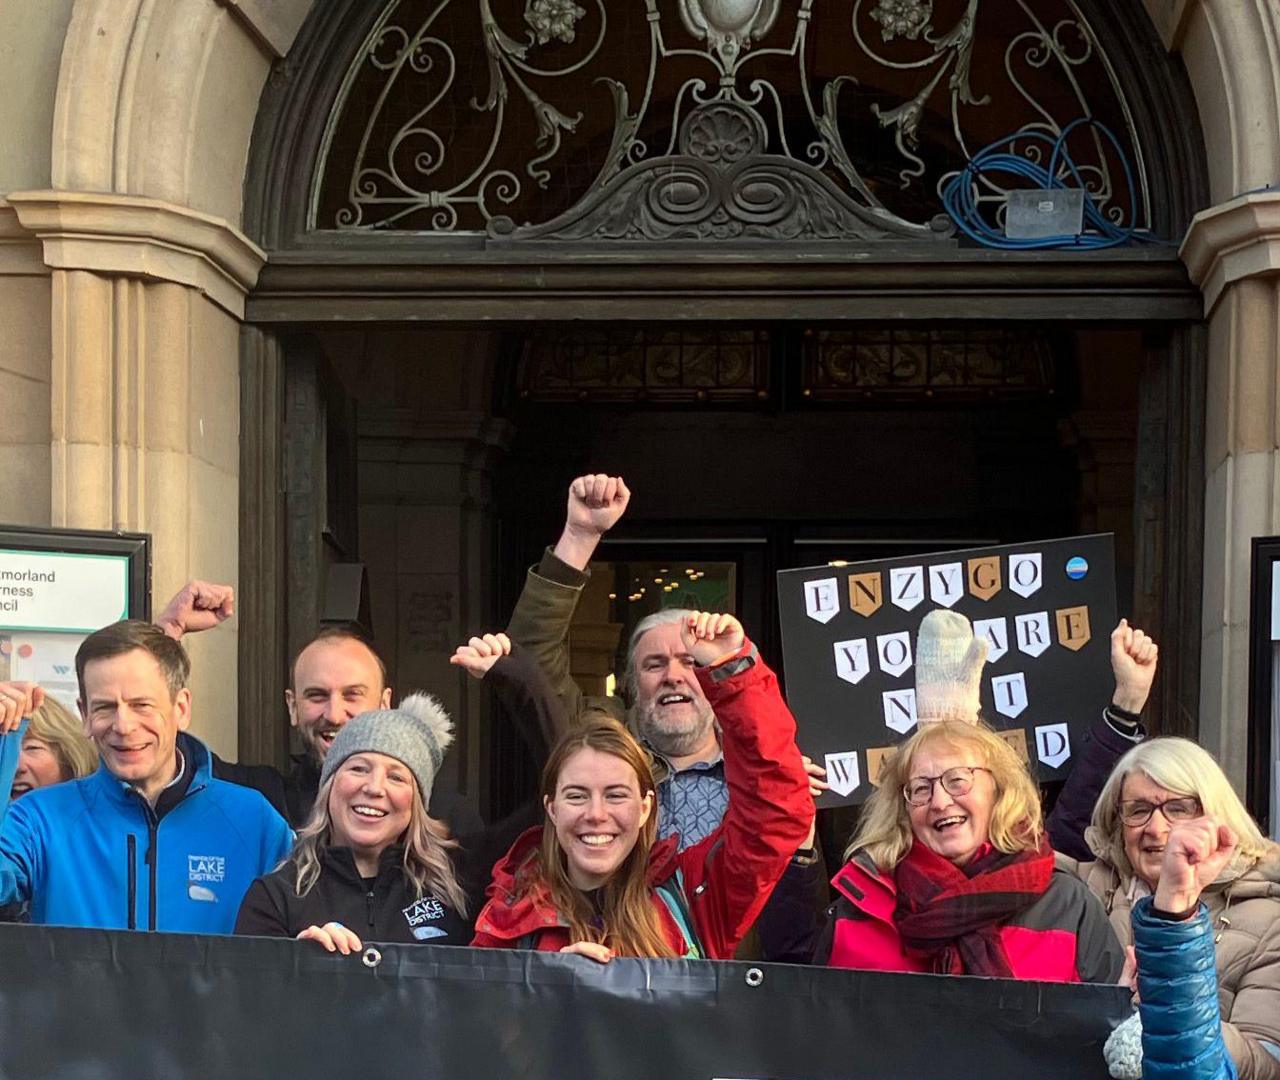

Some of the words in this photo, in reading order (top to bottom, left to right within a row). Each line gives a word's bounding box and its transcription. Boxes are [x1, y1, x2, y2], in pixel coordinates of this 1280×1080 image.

[810, 559, 1038, 613] ENZYGO
[888, 679, 1021, 724] NT
[189, 860, 225, 875] LAKE
[404, 900, 443, 921] LAKE
